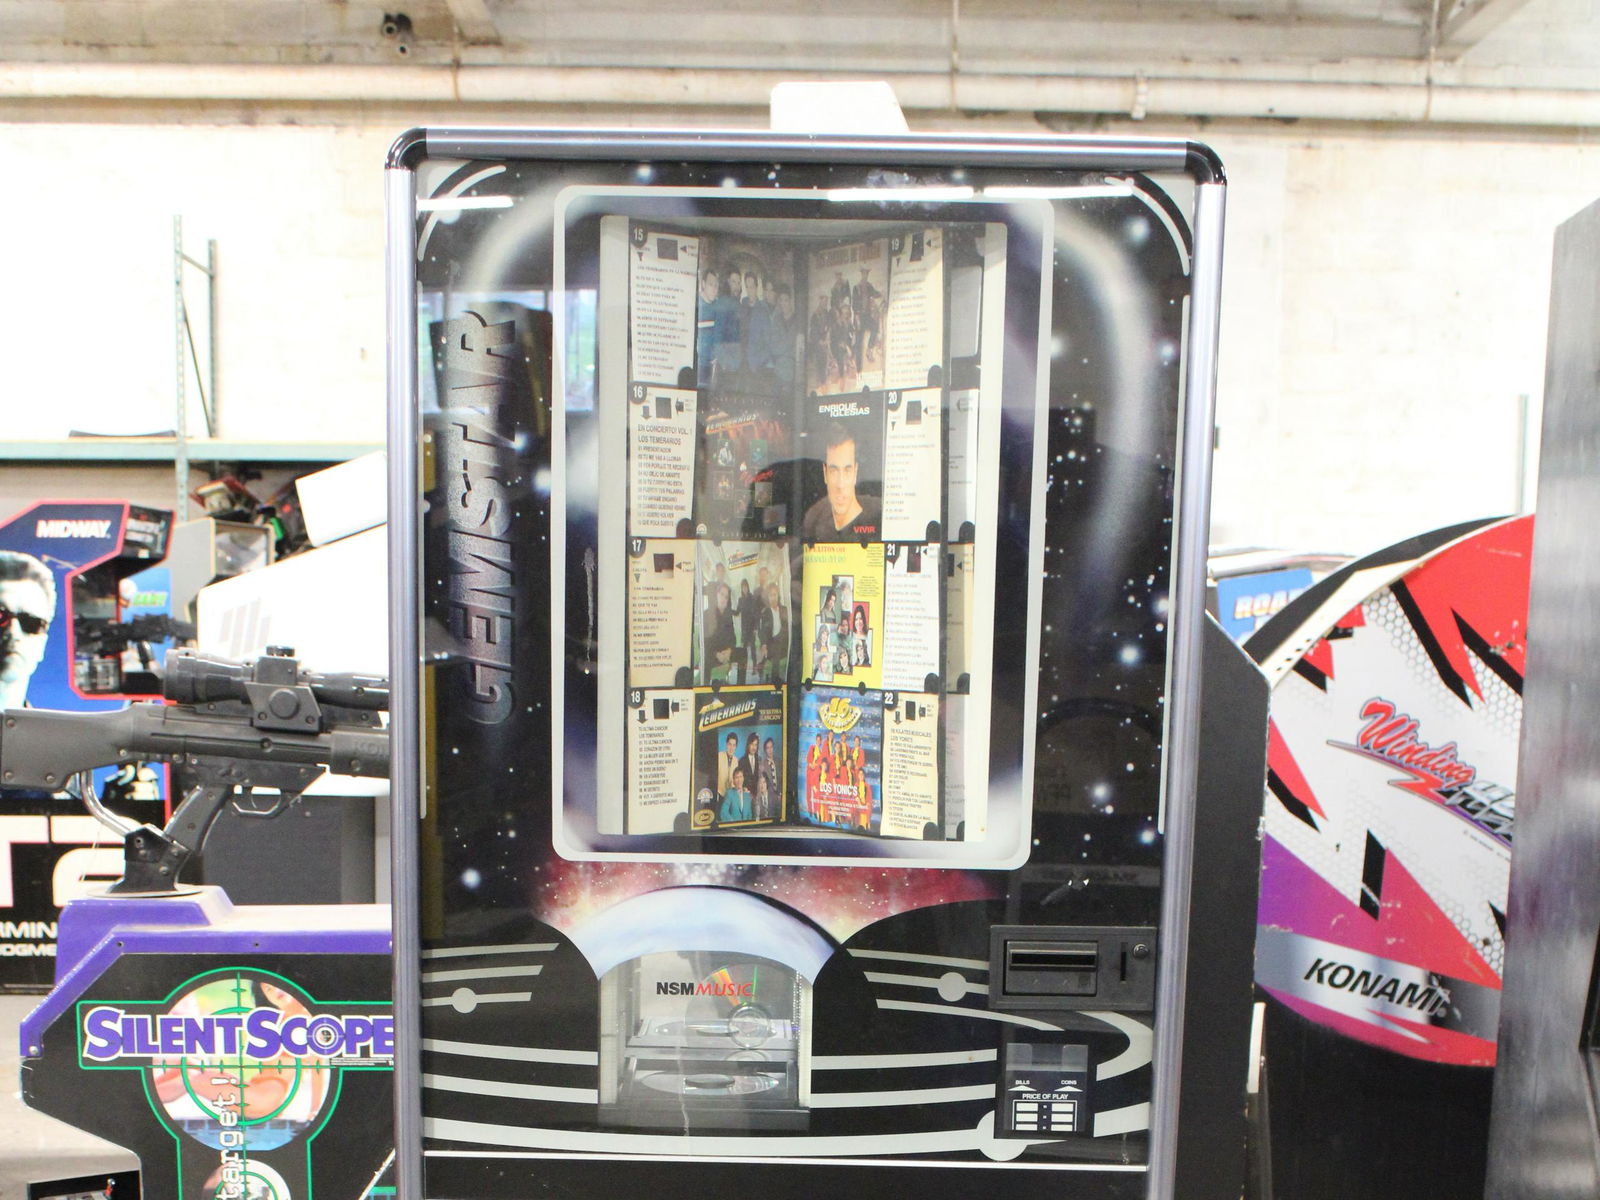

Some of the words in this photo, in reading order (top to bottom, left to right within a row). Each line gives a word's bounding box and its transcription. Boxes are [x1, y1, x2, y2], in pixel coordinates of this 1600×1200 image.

[633, 228, 643, 241] 15
[633, 385, 643, 398] 16
[888, 391, 897, 404] 20
[819, 402, 857, 414] ENRIQUE
[830, 406, 870, 418] IGLESIAS
[447, 311, 514, 725] GEMSTAR
[36, 520, 111, 539] MIDWAY
[853, 525, 875, 534] VIVIR
[632, 539, 642, 552] 17
[887, 544, 895, 556] 21
[631, 691, 641, 703] 18
[884, 692, 894, 704] 22
[1357, 696, 1476, 790] Winding
[820, 782, 832, 794] LOS
[656, 982, 694, 996] NSM
[695, 982, 753, 997] MUSIC
[1303, 957, 1446, 1013] KONAMI
[83, 1006, 243, 1061] SILENT
[245, 1006, 394, 1061] SCOPE
